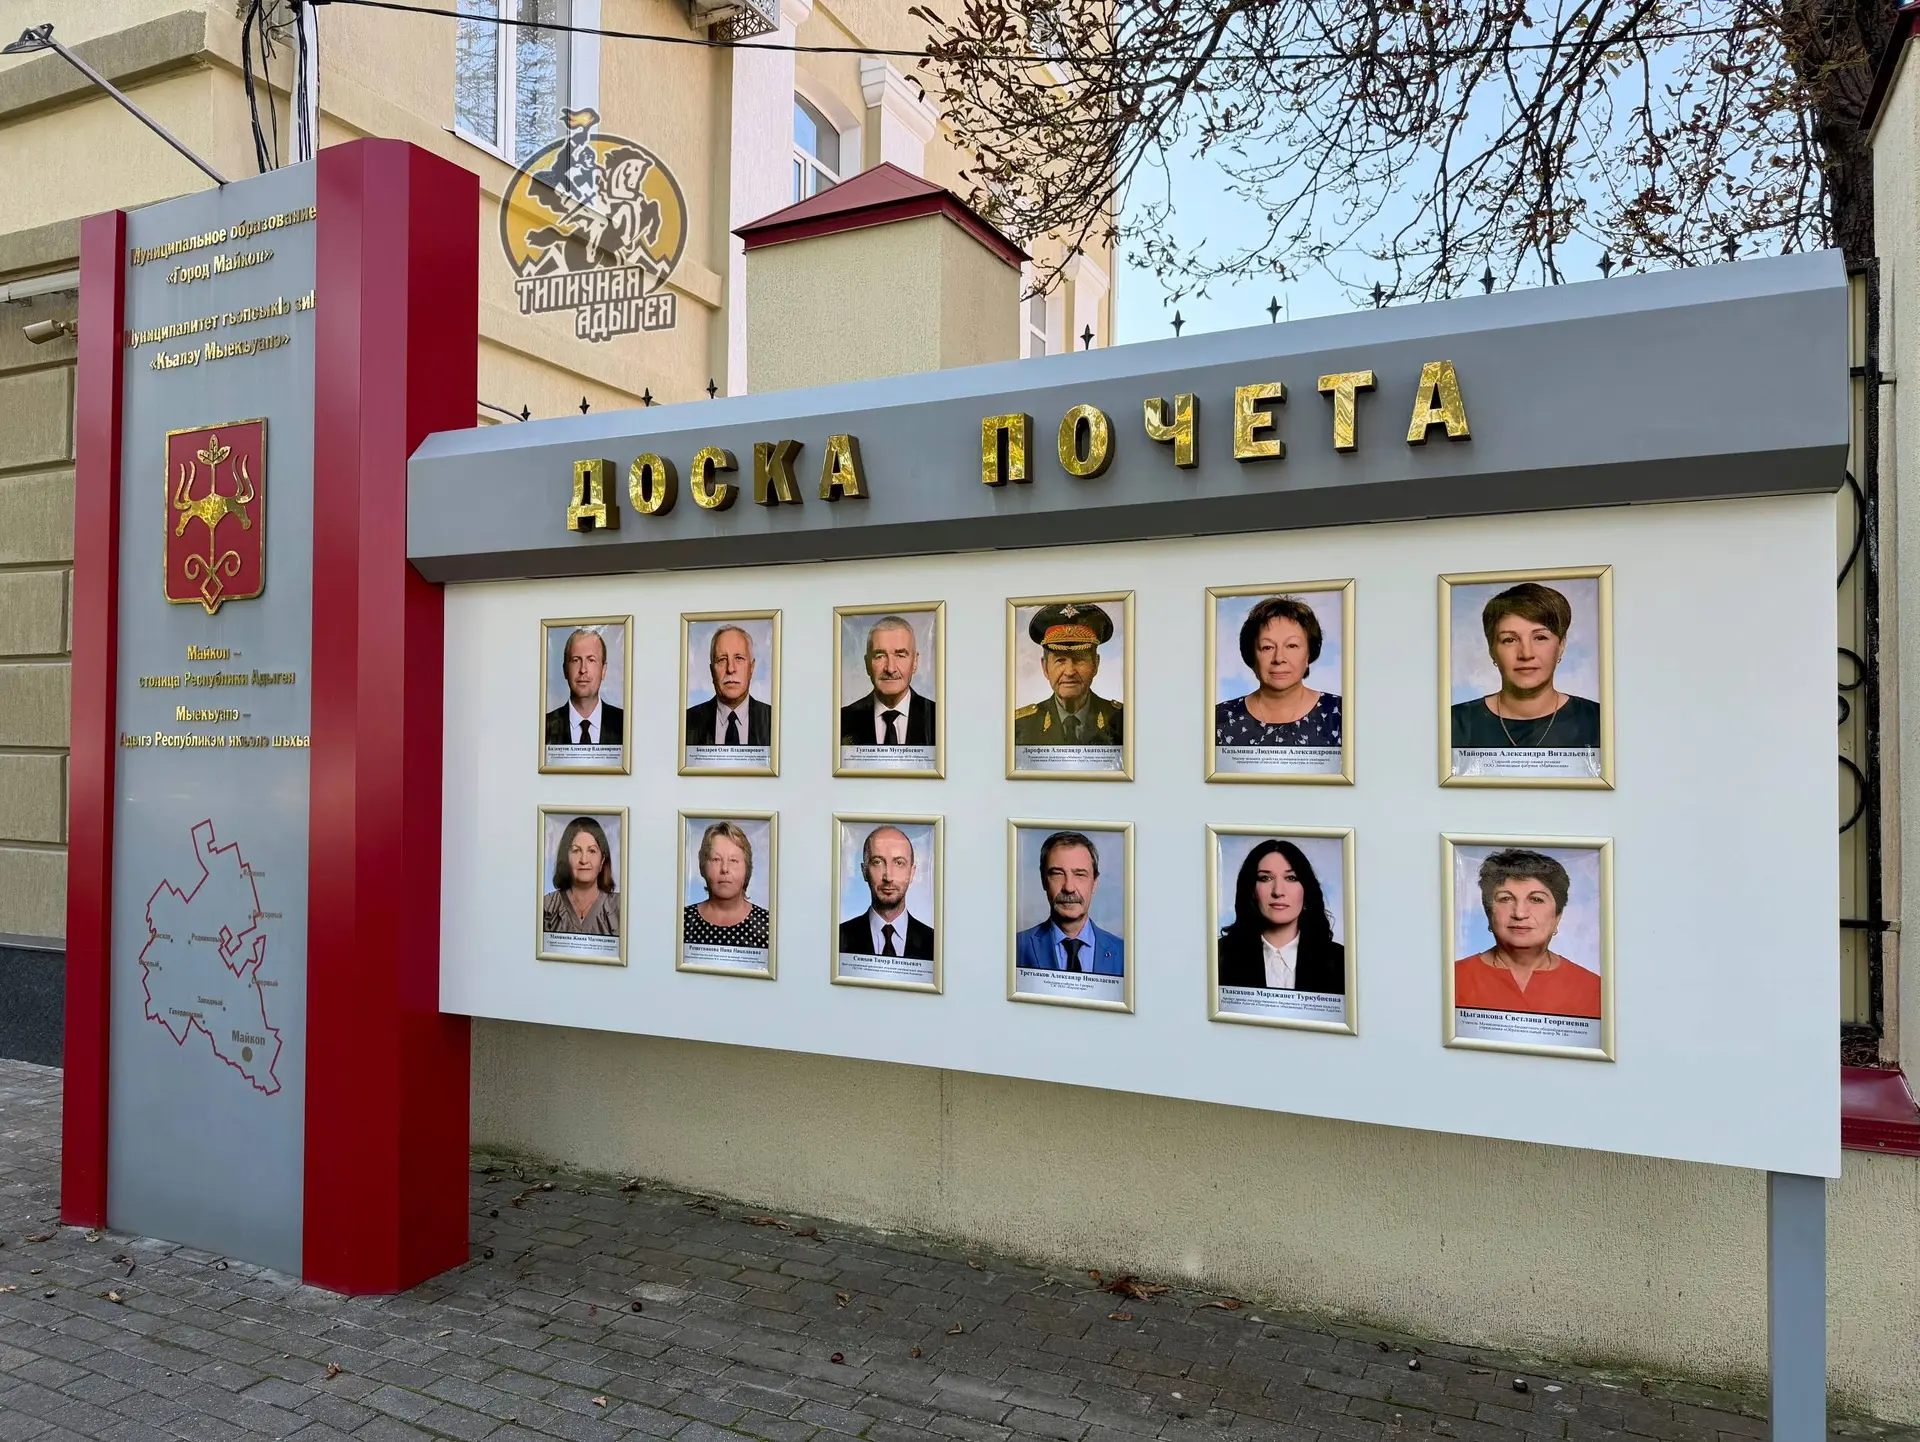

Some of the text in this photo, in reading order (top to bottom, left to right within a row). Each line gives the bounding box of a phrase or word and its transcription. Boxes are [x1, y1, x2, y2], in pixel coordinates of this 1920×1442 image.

[131, 206, 316, 266] Муниципальное образование
[166, 249, 274, 284] «Город Майкоп»
[125, 314, 218, 349] Муниципалитет
[567, 360, 1472, 532] ДОСКА ПОЧЕТА
[187, 644, 230, 661] Майкоп
[138, 669, 296, 688] столица Республики Адыгея
[120, 733, 152, 749] Адыгэ
[155, 731, 225, 750] Республикэм
[1458, 750, 1498, 758] Майорова
[1499, 750, 1546, 758] Александра
[1019, 970, 1120, 985] Третьяков Александр Николаевич
[1256, 990, 1296, 1000] Марджанет
[1460, 1010, 1590, 1028] Цыганкова Светлана Георгиевна
[231, 1030, 266, 1046] Майкоп
